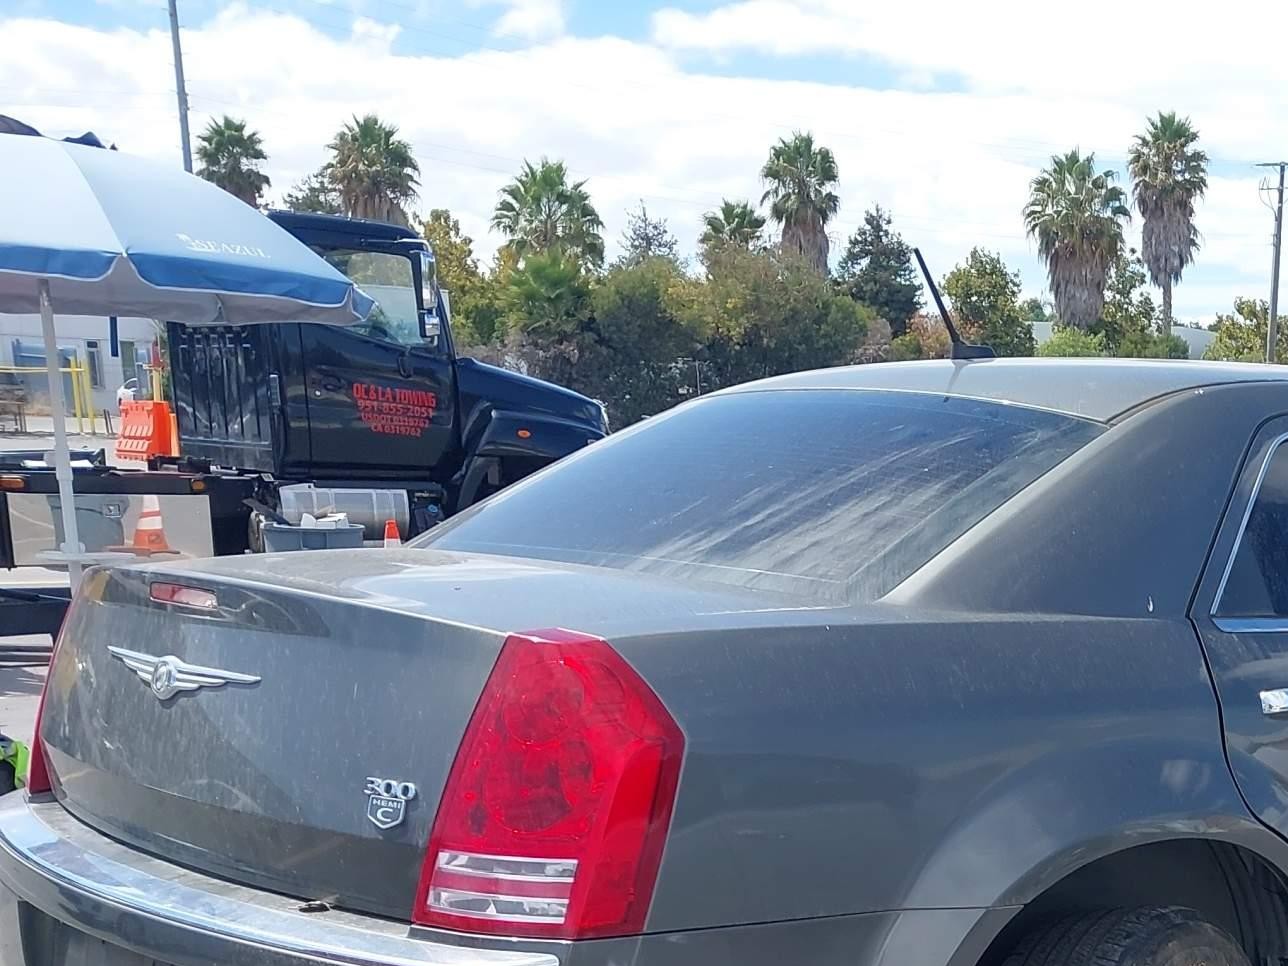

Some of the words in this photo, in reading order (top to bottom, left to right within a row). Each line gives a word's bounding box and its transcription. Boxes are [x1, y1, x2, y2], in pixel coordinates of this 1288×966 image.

[378, 386, 393, 402] LA
[395, 389, 436, 408] TOWING
[357, 399, 434, 418] 951-855-2051
[363, 776, 416, 800] 300
[372, 798, 401, 809] HEMI
[376, 807, 394, 822] C
